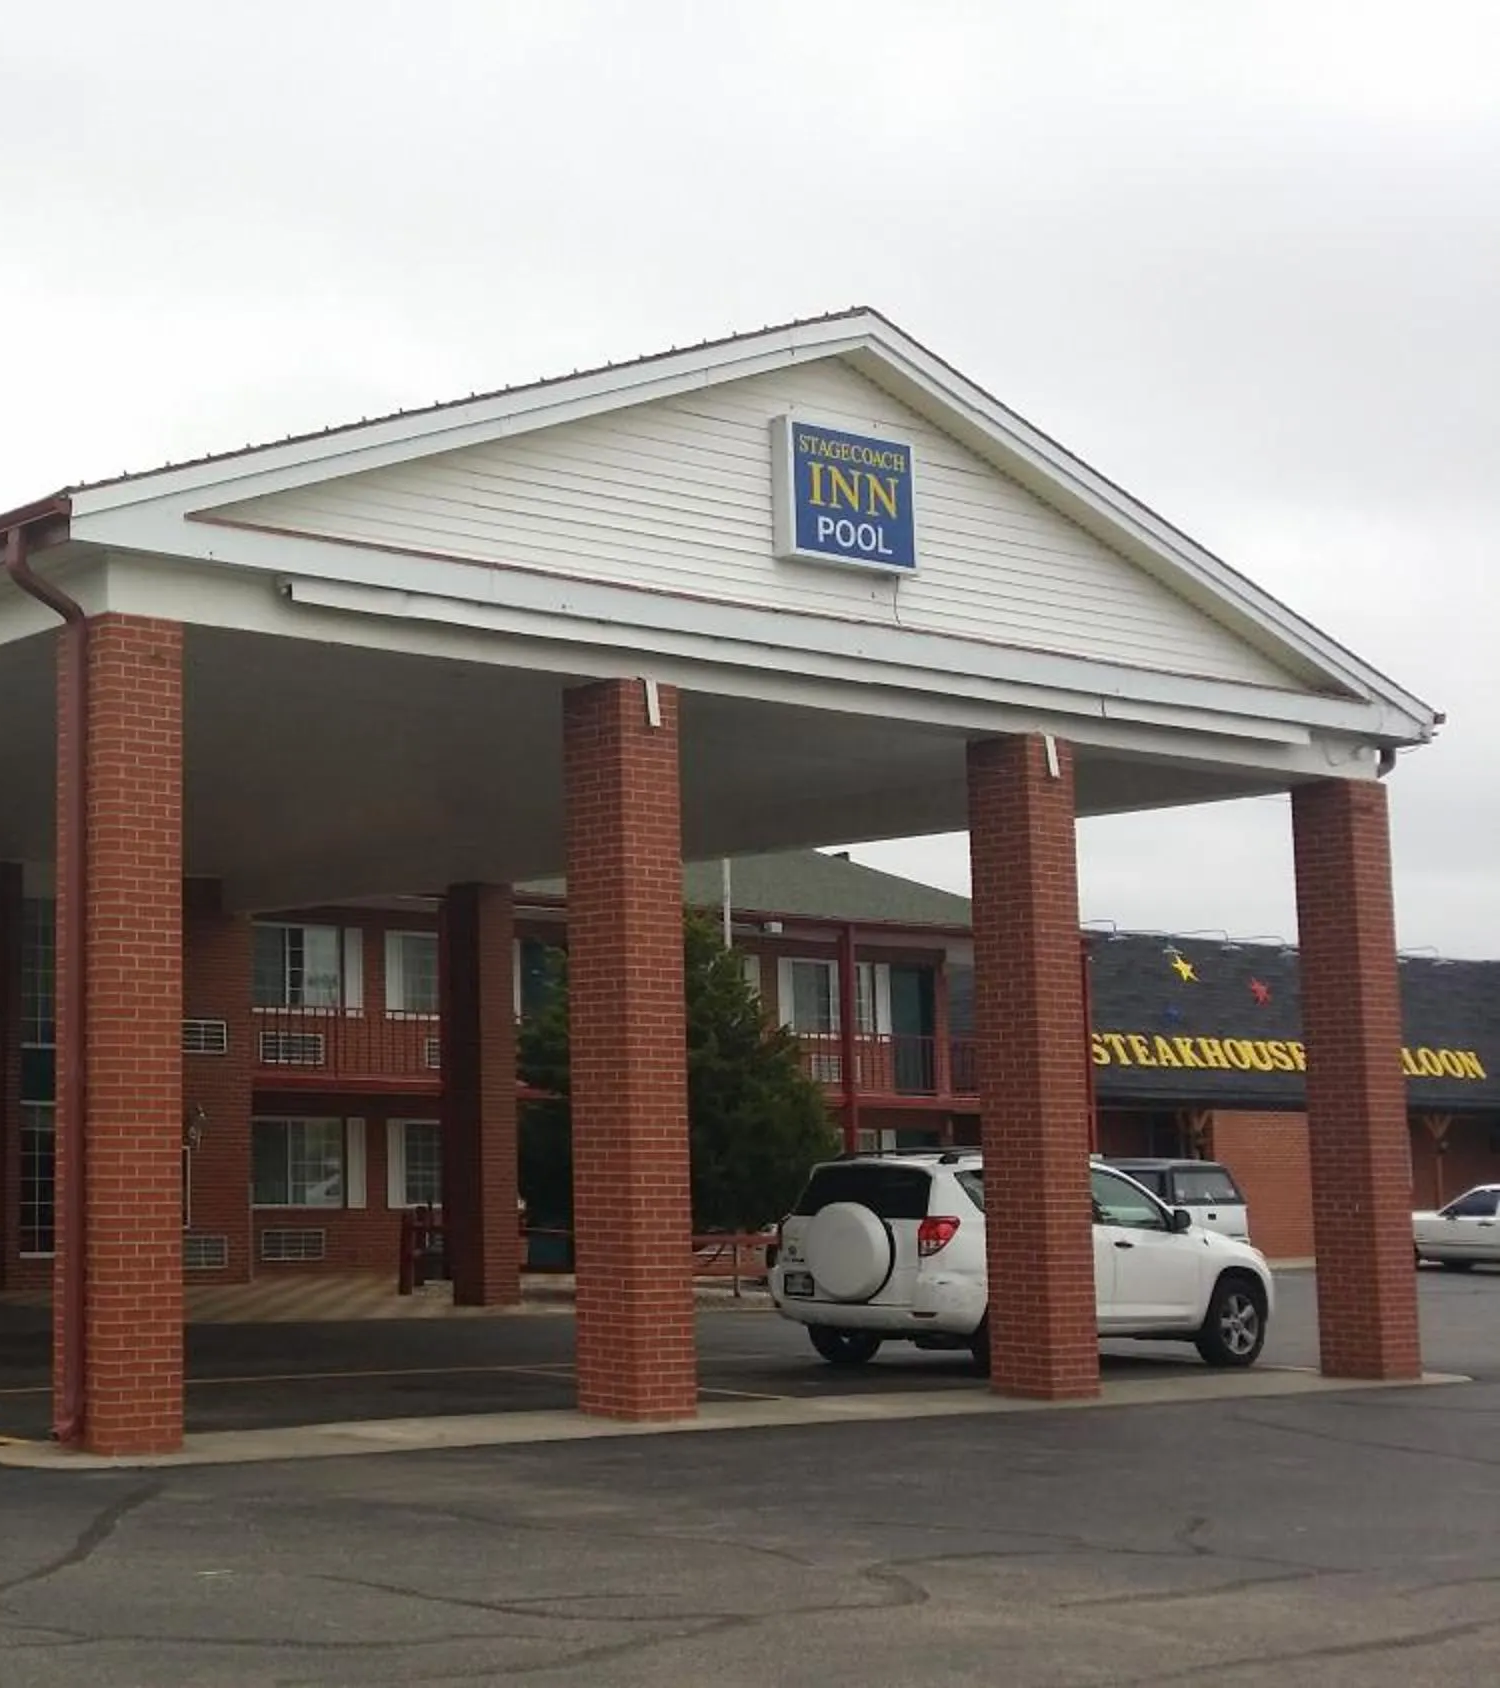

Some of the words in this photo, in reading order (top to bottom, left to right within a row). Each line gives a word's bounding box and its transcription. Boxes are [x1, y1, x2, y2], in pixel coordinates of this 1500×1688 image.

[799, 433, 906, 474] STAGECOACH
[807, 461, 899, 519] INN
[817, 515, 893, 555] POOL
